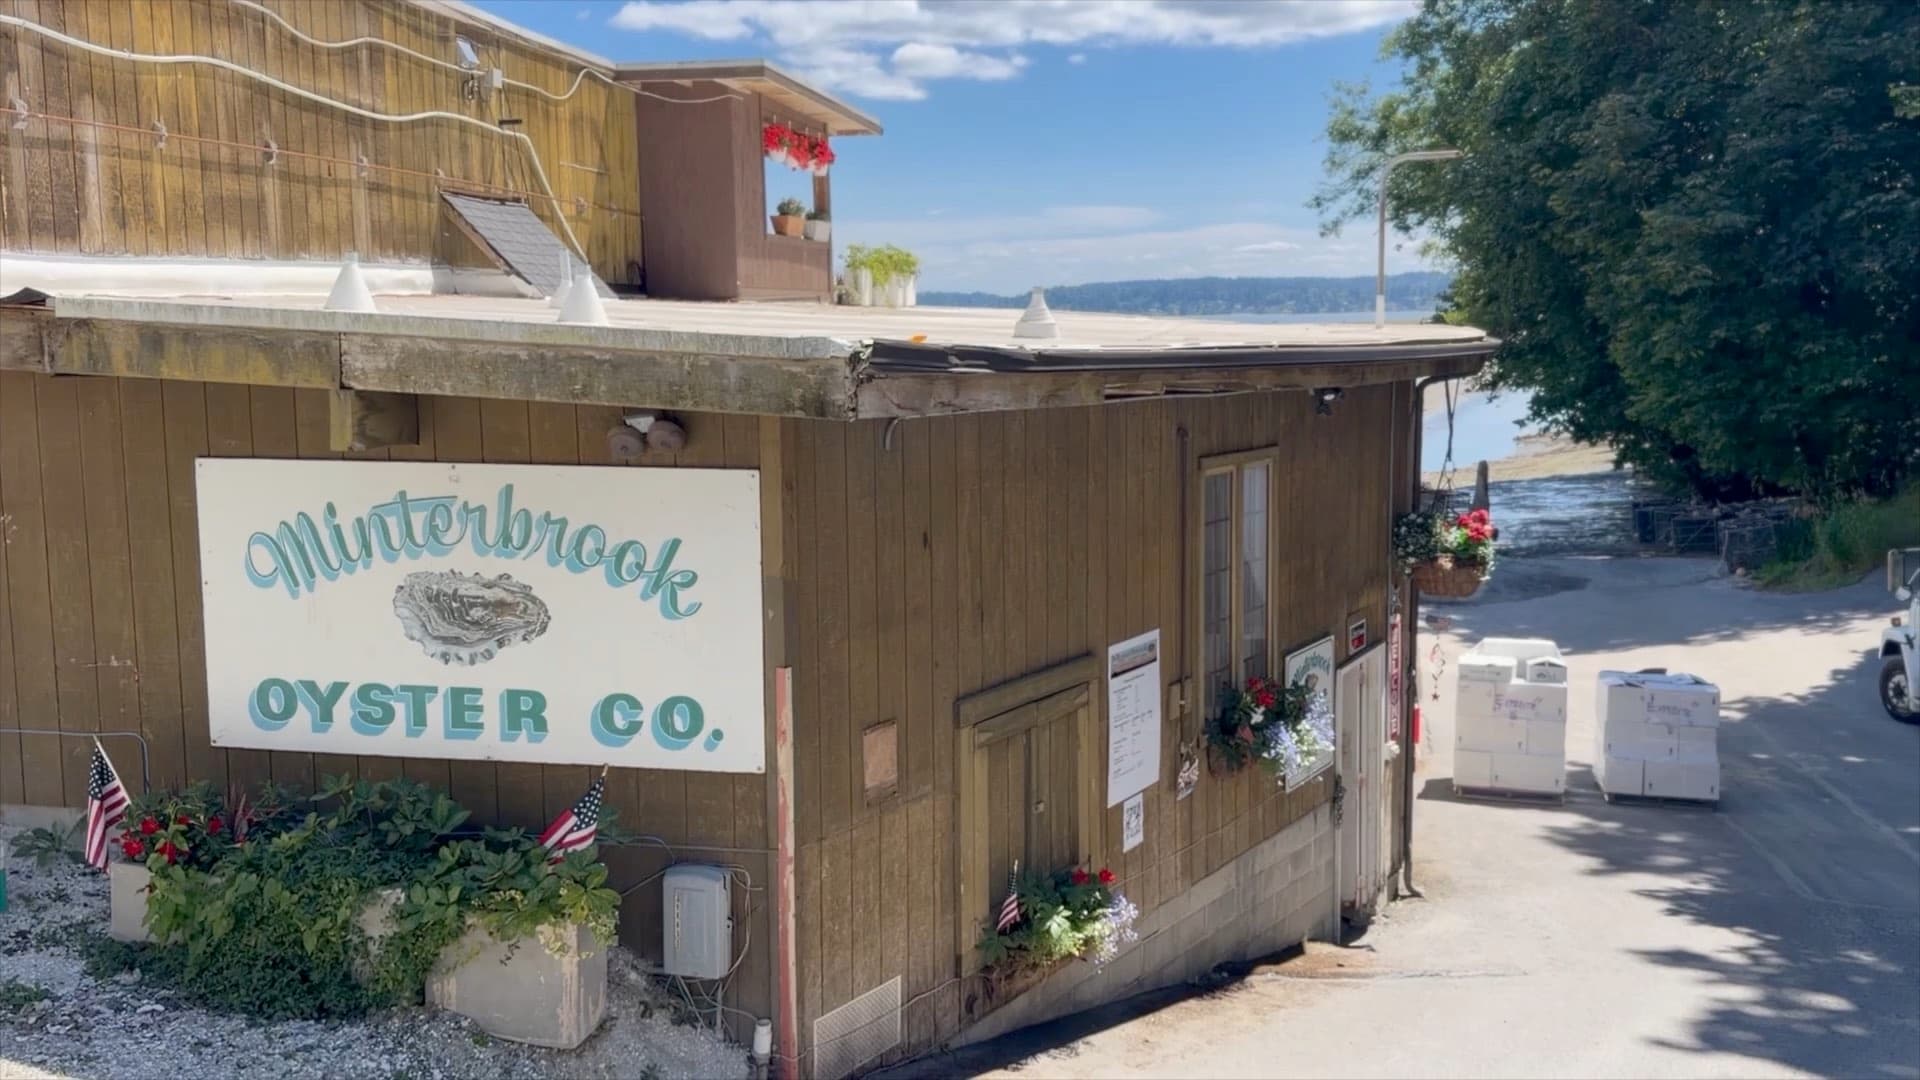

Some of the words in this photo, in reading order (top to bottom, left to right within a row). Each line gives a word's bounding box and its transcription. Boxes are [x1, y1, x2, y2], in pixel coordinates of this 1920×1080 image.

[245, 484, 703, 620] Minterbrook
[249, 677, 548, 744] OYSTER
[590, 692, 725, 753] CO.
